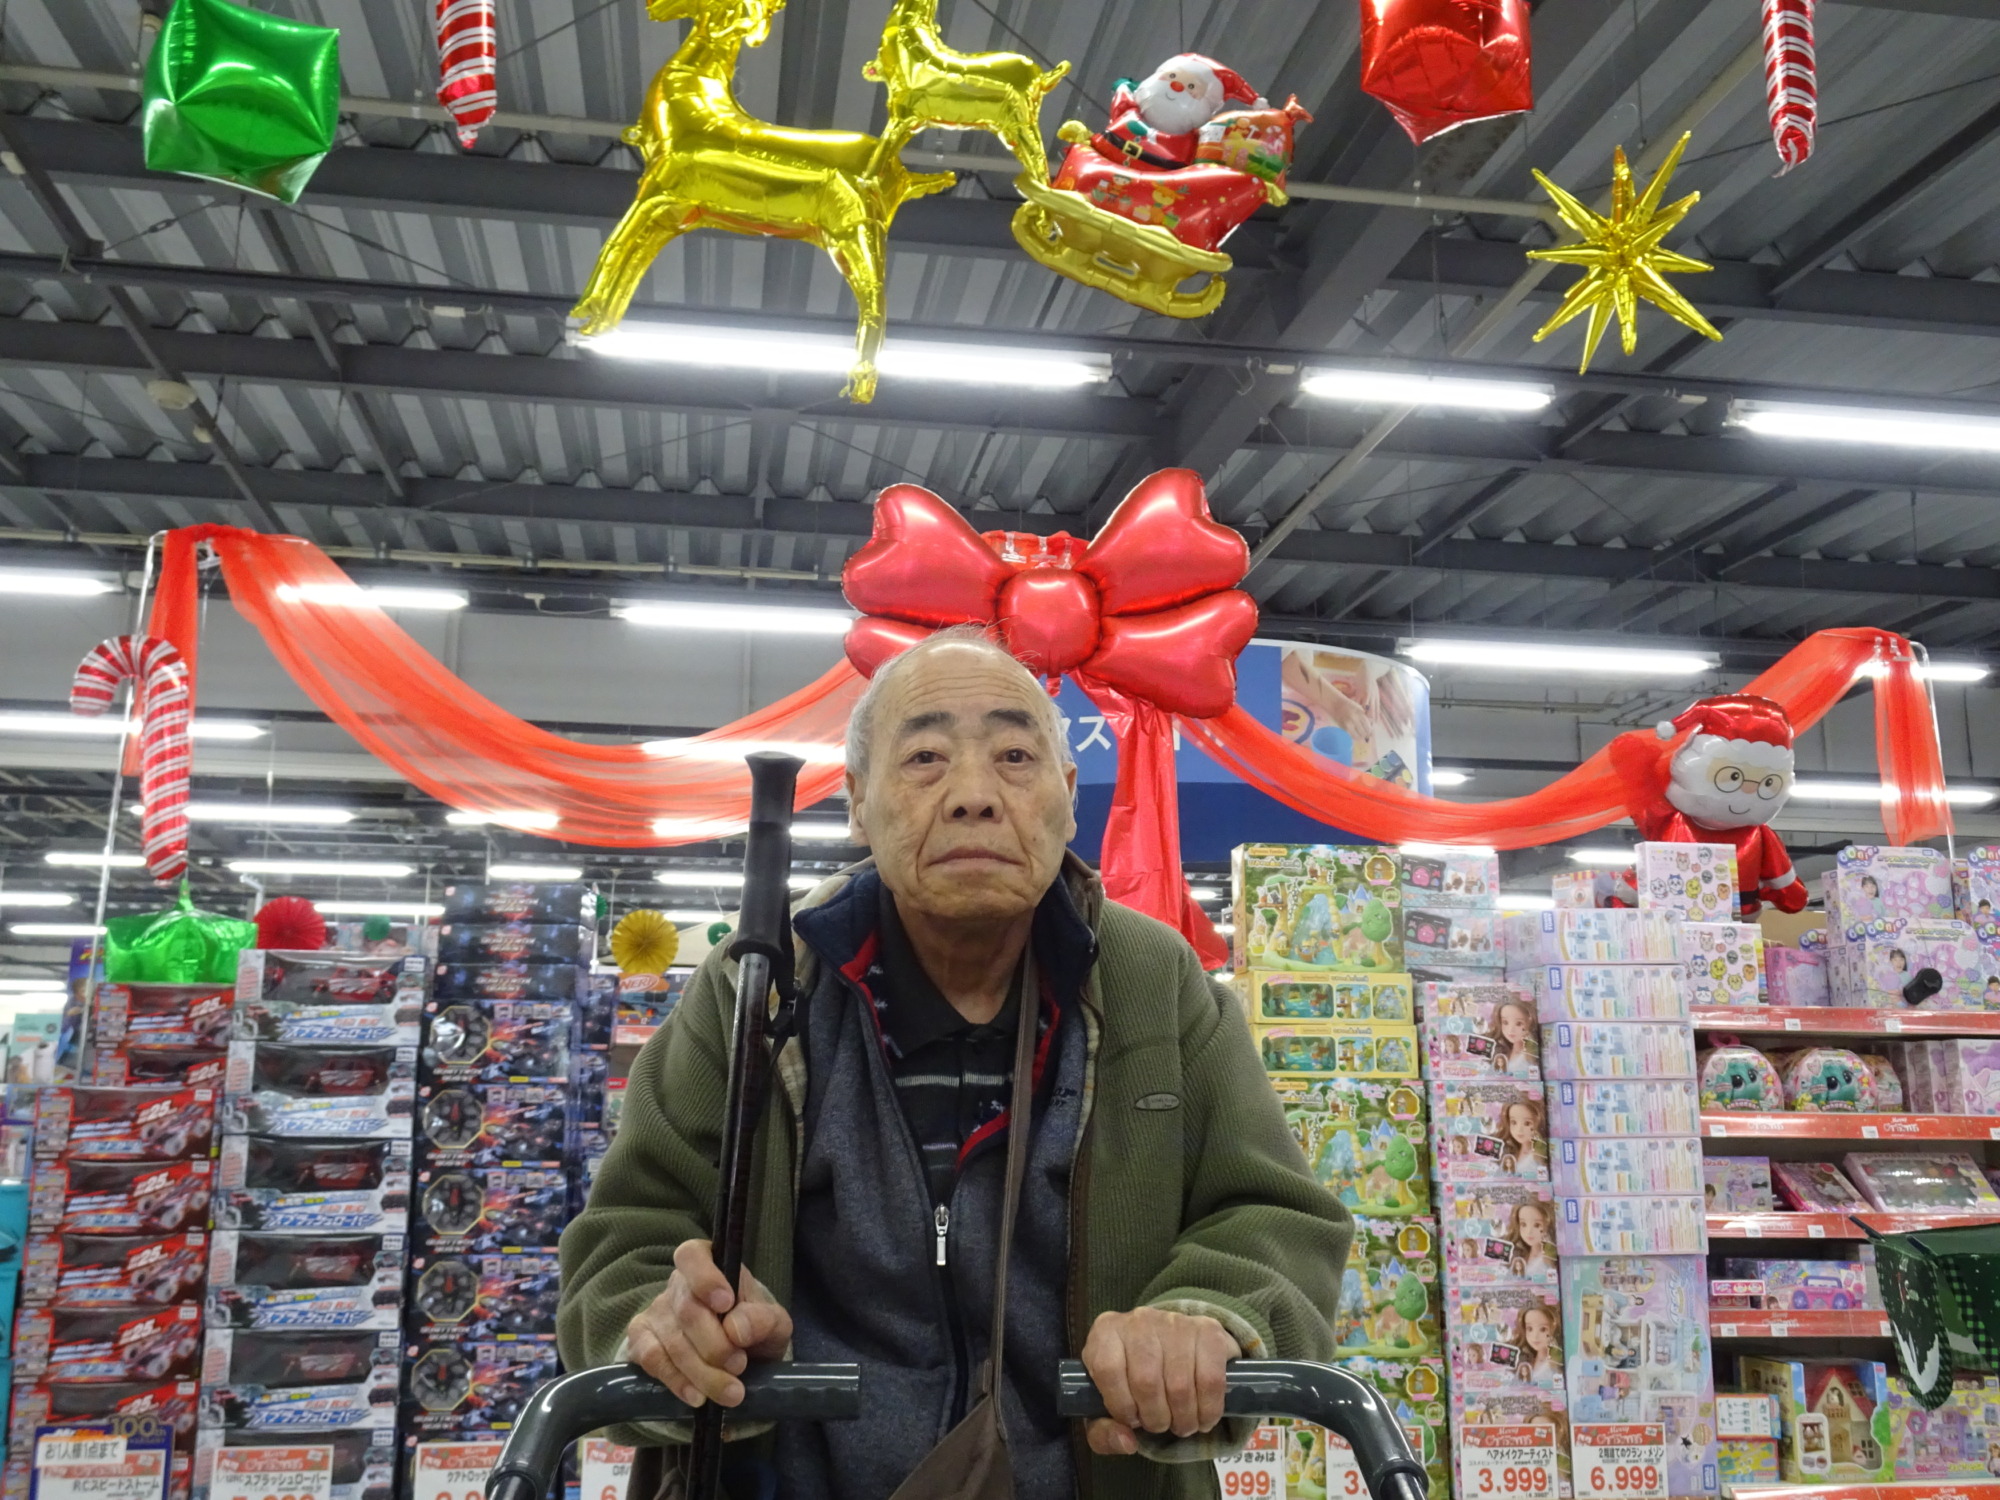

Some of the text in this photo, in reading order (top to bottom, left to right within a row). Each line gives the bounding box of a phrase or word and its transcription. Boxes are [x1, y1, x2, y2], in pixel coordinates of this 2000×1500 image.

[1487, 1448, 1553, 1460] ヘアメイクアーティスト
[1478, 1466, 1547, 1494] 3,999
[1590, 1465, 1658, 1493] 6,999
